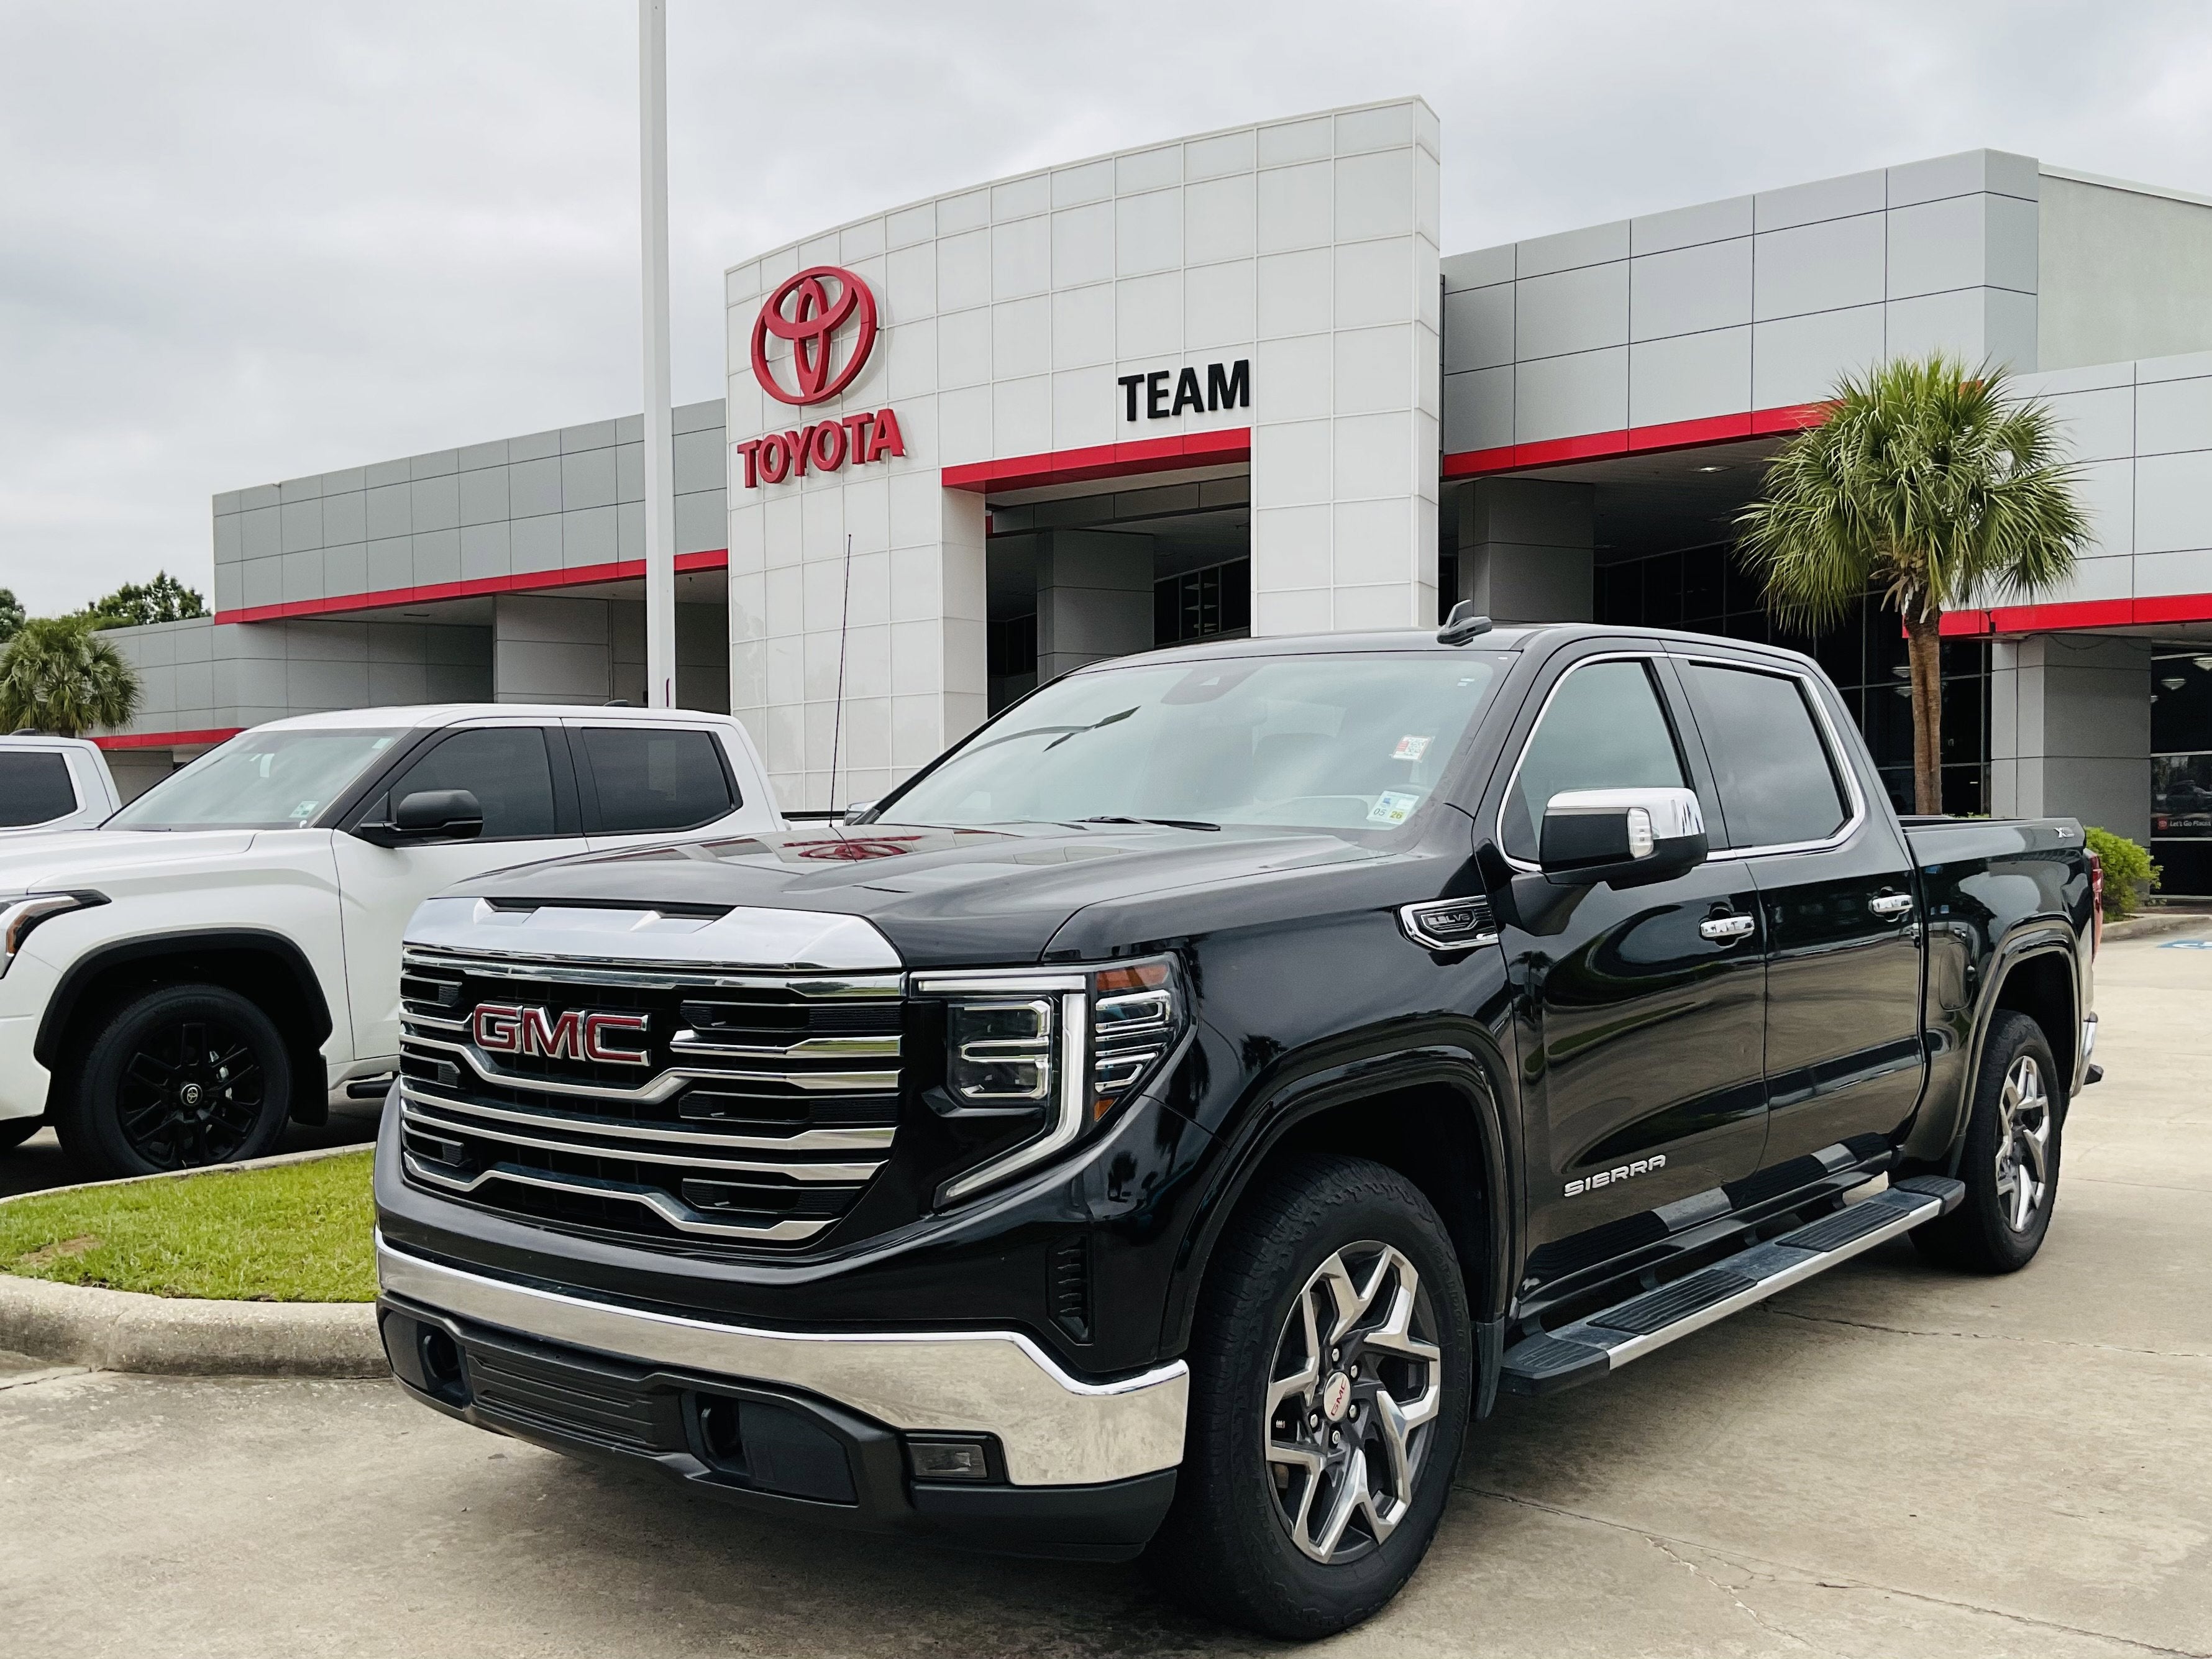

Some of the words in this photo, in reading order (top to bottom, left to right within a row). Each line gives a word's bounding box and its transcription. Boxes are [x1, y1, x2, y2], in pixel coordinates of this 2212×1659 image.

[1118, 359, 1250, 421] TEAM
[737, 408, 905, 488] TOYOTA
[1390, 811, 1403, 819] 26
[473, 1003, 651, 1067] GMC
[1564, 1154, 1666, 1197] SIERRA
[1330, 1377, 1347, 1416] GMC
